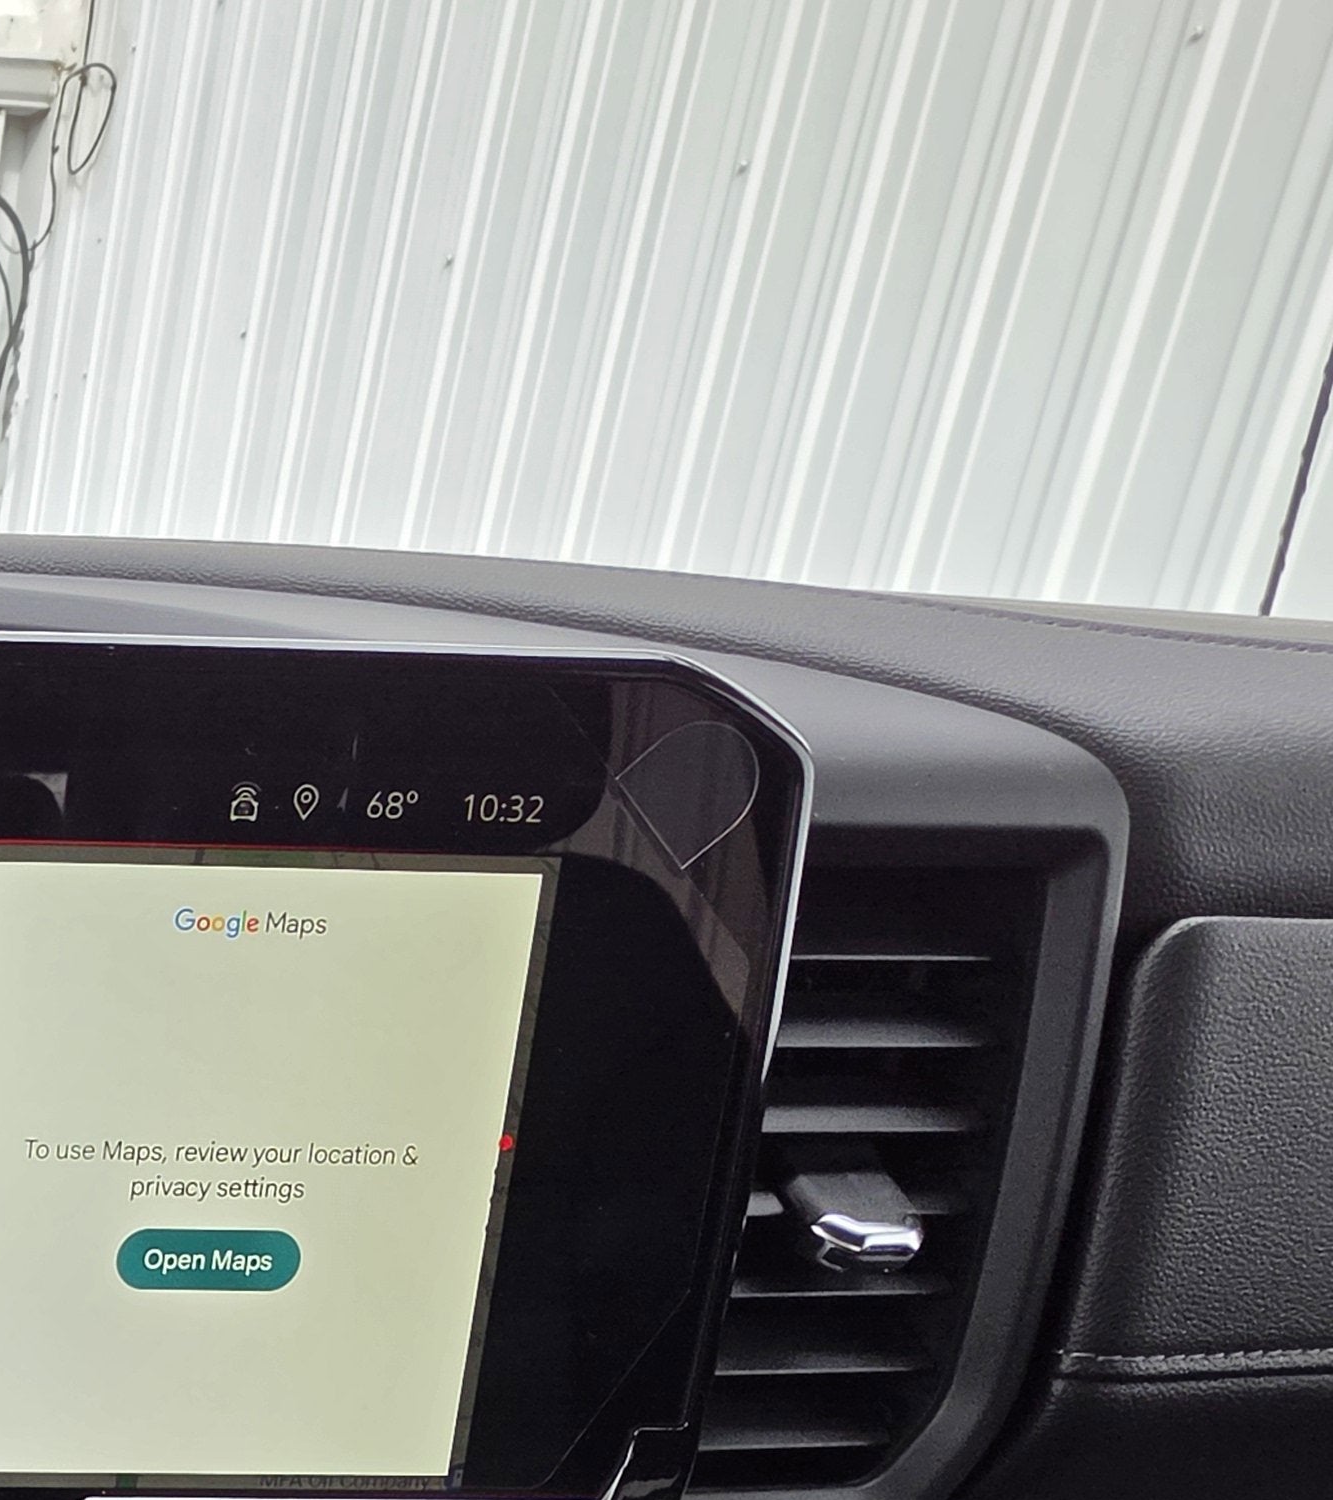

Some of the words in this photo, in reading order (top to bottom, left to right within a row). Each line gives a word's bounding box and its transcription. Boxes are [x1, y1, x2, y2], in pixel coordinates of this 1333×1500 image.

[462, 794, 545, 824] 10:32
[174, 908, 260, 940] Google
[265, 911, 328, 939] Maps
[25, 1139, 50, 1160] To
[55, 1144, 95, 1161] use
[102, 1141, 168, 1166] Maps,
[175, 1143, 247, 1163] review
[252, 1146, 302, 1168] your
[307, 1142, 396, 1166] location
[401, 1145, 419, 1166] &
[129, 1177, 212, 1202] privacy
[216, 1178, 305, 1203] settings
[143, 1247, 205, 1276] Open
[211, 1249, 273, 1277] Maps
